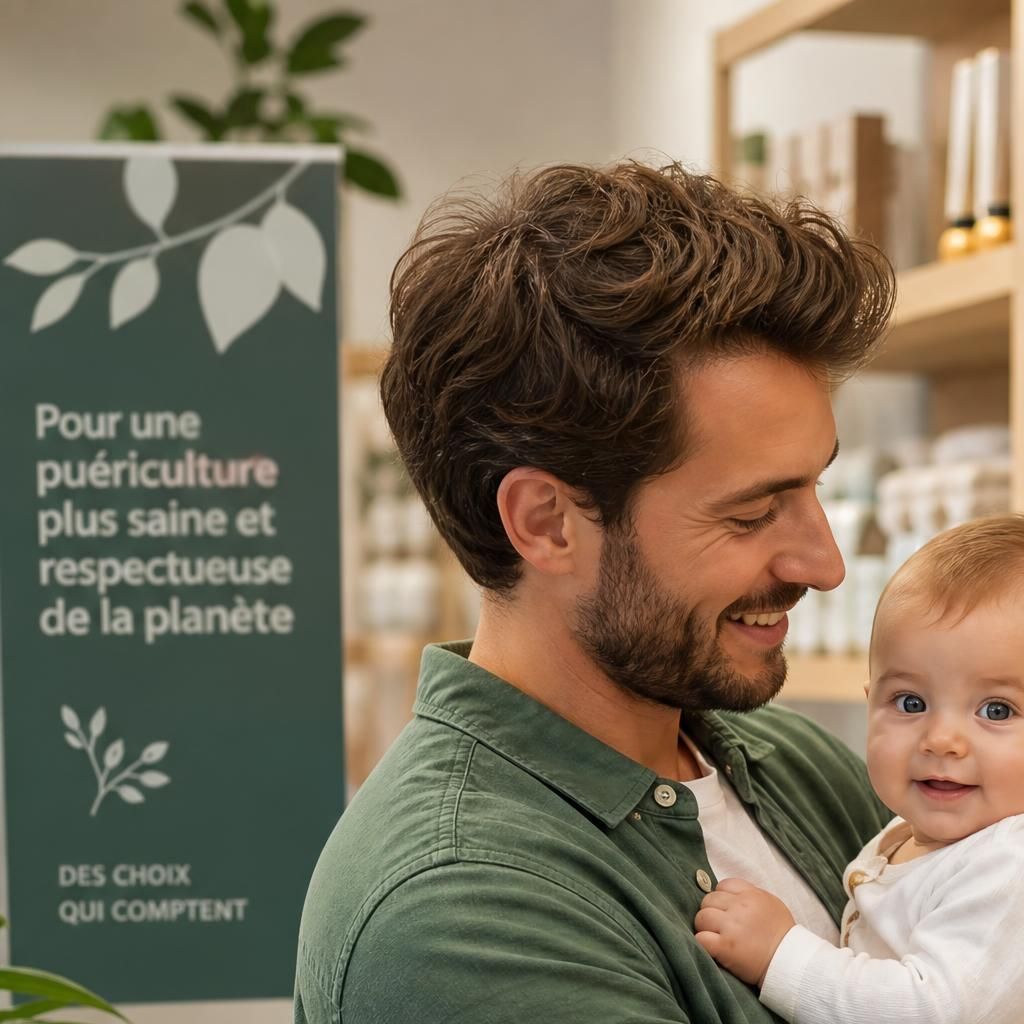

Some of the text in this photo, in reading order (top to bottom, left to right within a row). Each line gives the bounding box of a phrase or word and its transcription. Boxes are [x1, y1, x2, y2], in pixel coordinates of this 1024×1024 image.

[35, 403, 201, 440] Pour une
[36, 450, 279, 498] puériculture
[38, 499, 277, 547] plus saine et
[39, 552, 292, 595] respectueuse
[39, 595, 294, 644] de la planète
[58, 863, 191, 887] DES CHOIX
[58, 898, 249, 925] QUI COMPTENT
